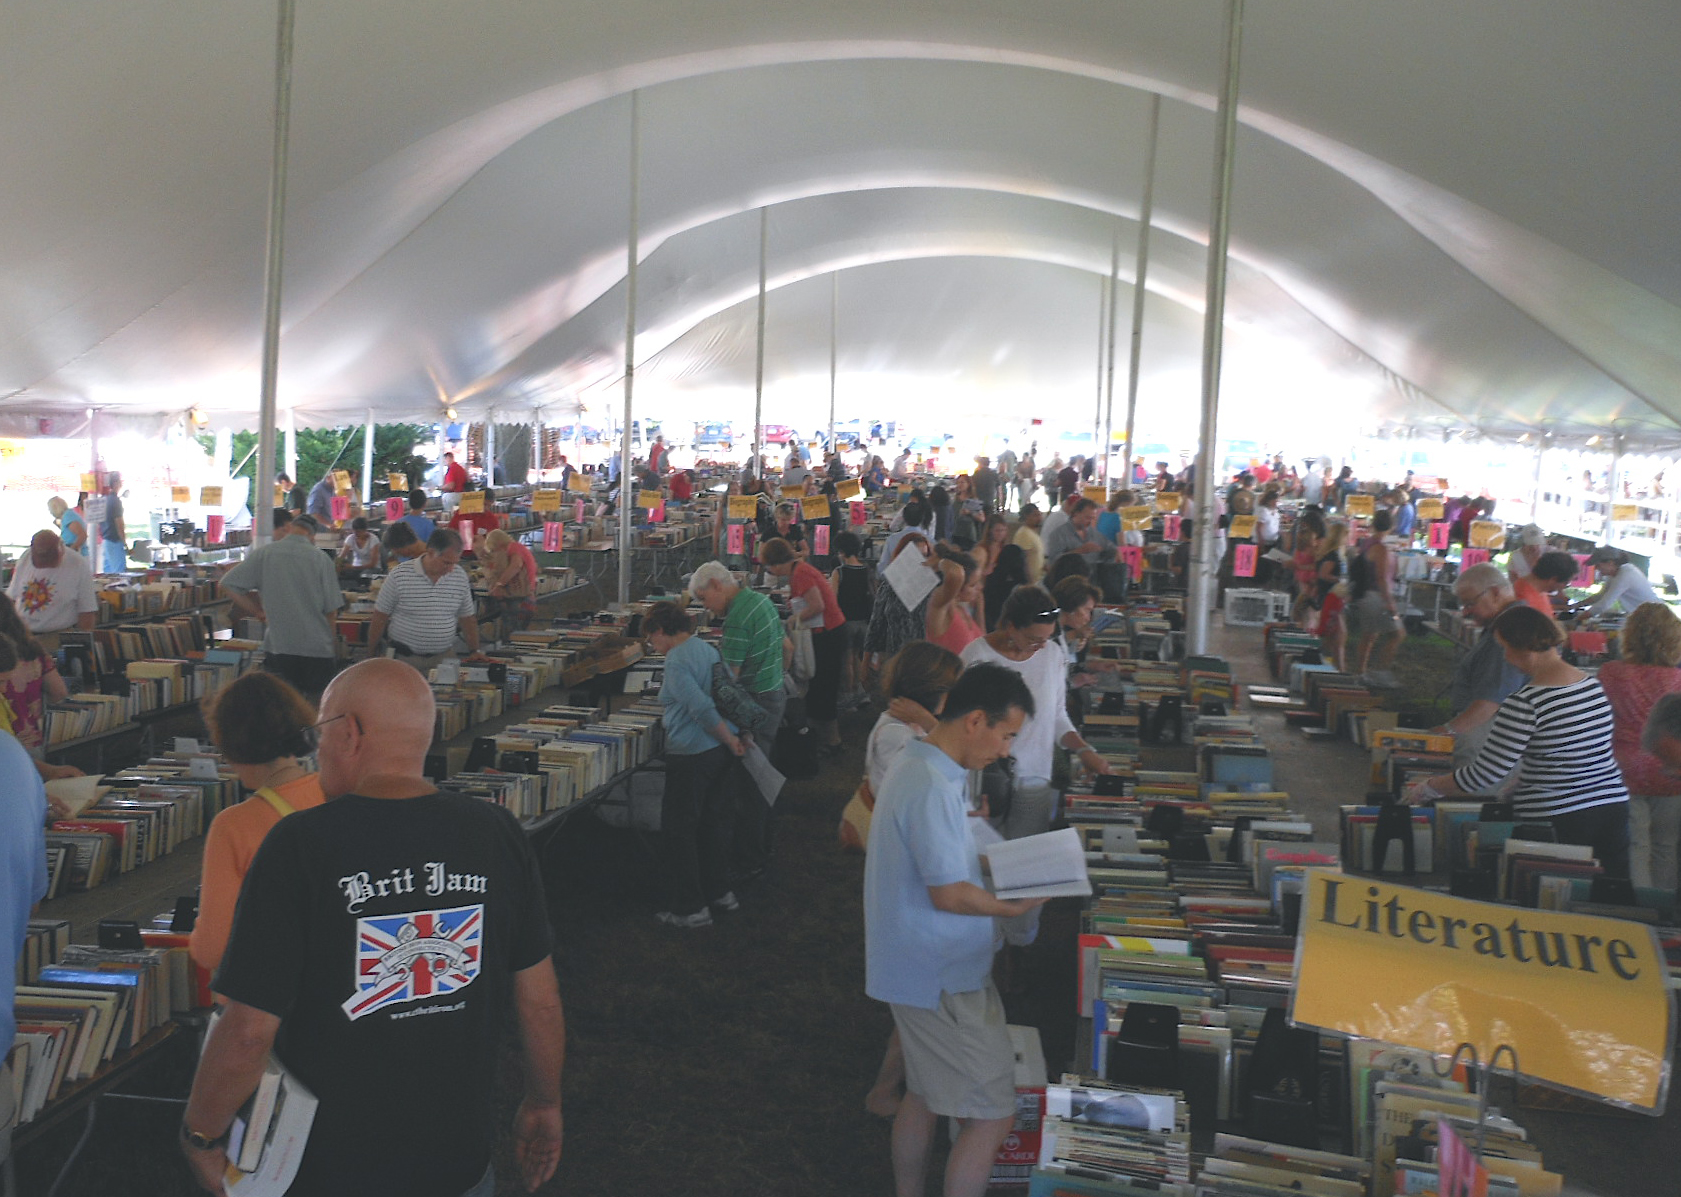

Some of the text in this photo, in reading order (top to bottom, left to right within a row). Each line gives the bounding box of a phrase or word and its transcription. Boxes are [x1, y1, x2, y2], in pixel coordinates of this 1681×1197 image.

[391, 500, 399, 516] 9
[1433, 527, 1443, 545] 1
[338, 862, 488, 914] Brit Jam
[1319, 878, 1640, 980] Literature
